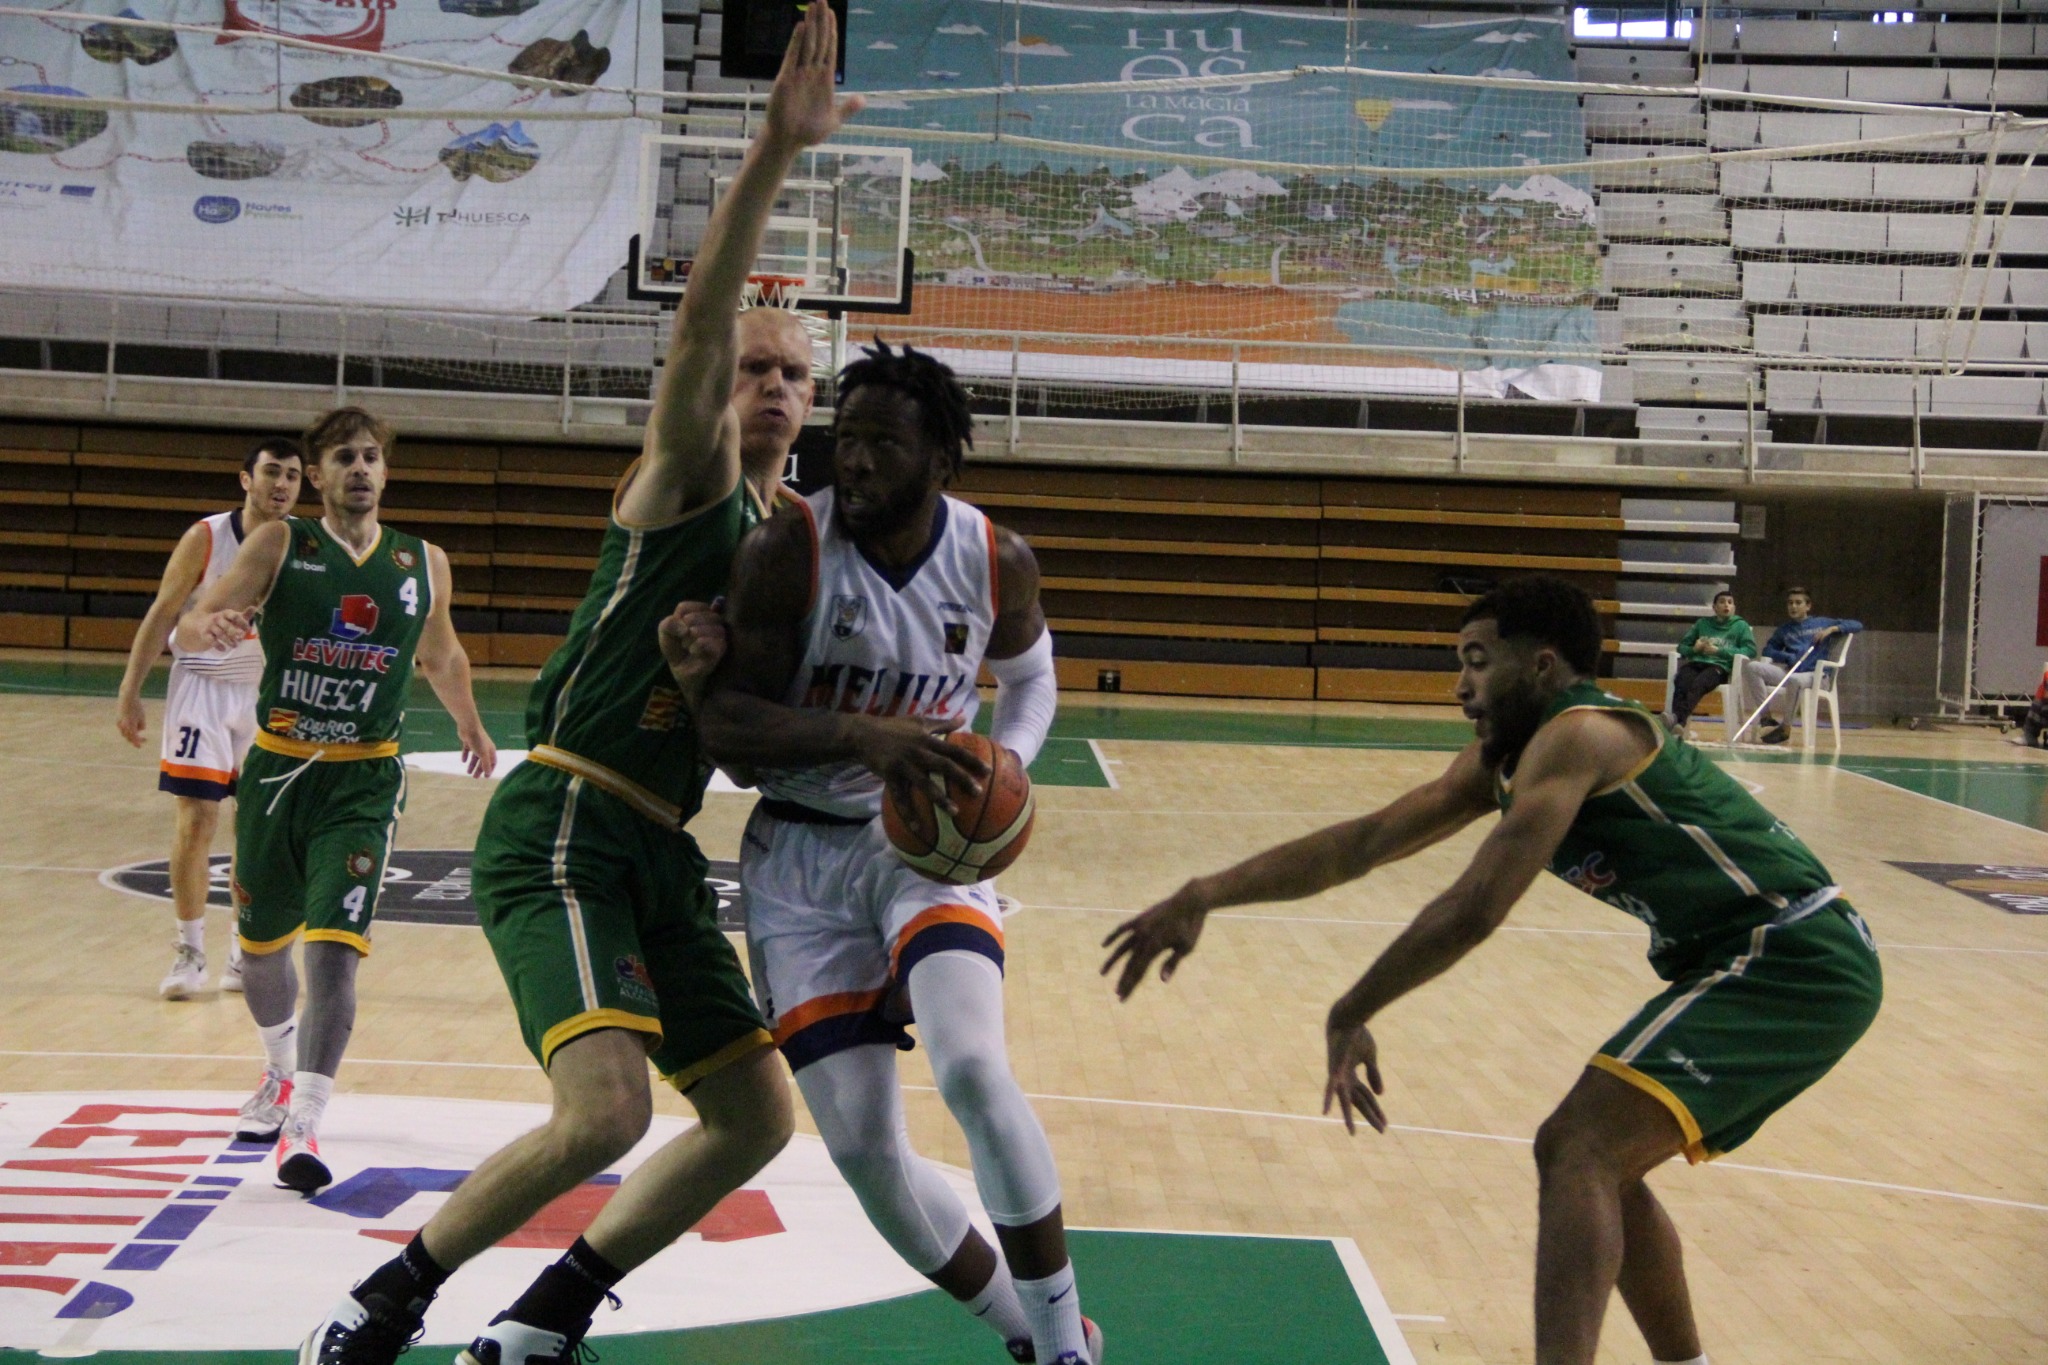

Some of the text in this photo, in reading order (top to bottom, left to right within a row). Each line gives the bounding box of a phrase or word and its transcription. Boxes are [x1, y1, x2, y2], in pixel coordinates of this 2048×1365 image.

[245, 202, 292, 213] Hautes
[399, 576, 419, 617] 4
[292, 637, 399, 674] LEVITEC
[280, 669, 378, 713] HUESCA
[175, 726, 201, 759] 31
[342, 884, 367, 923] 4
